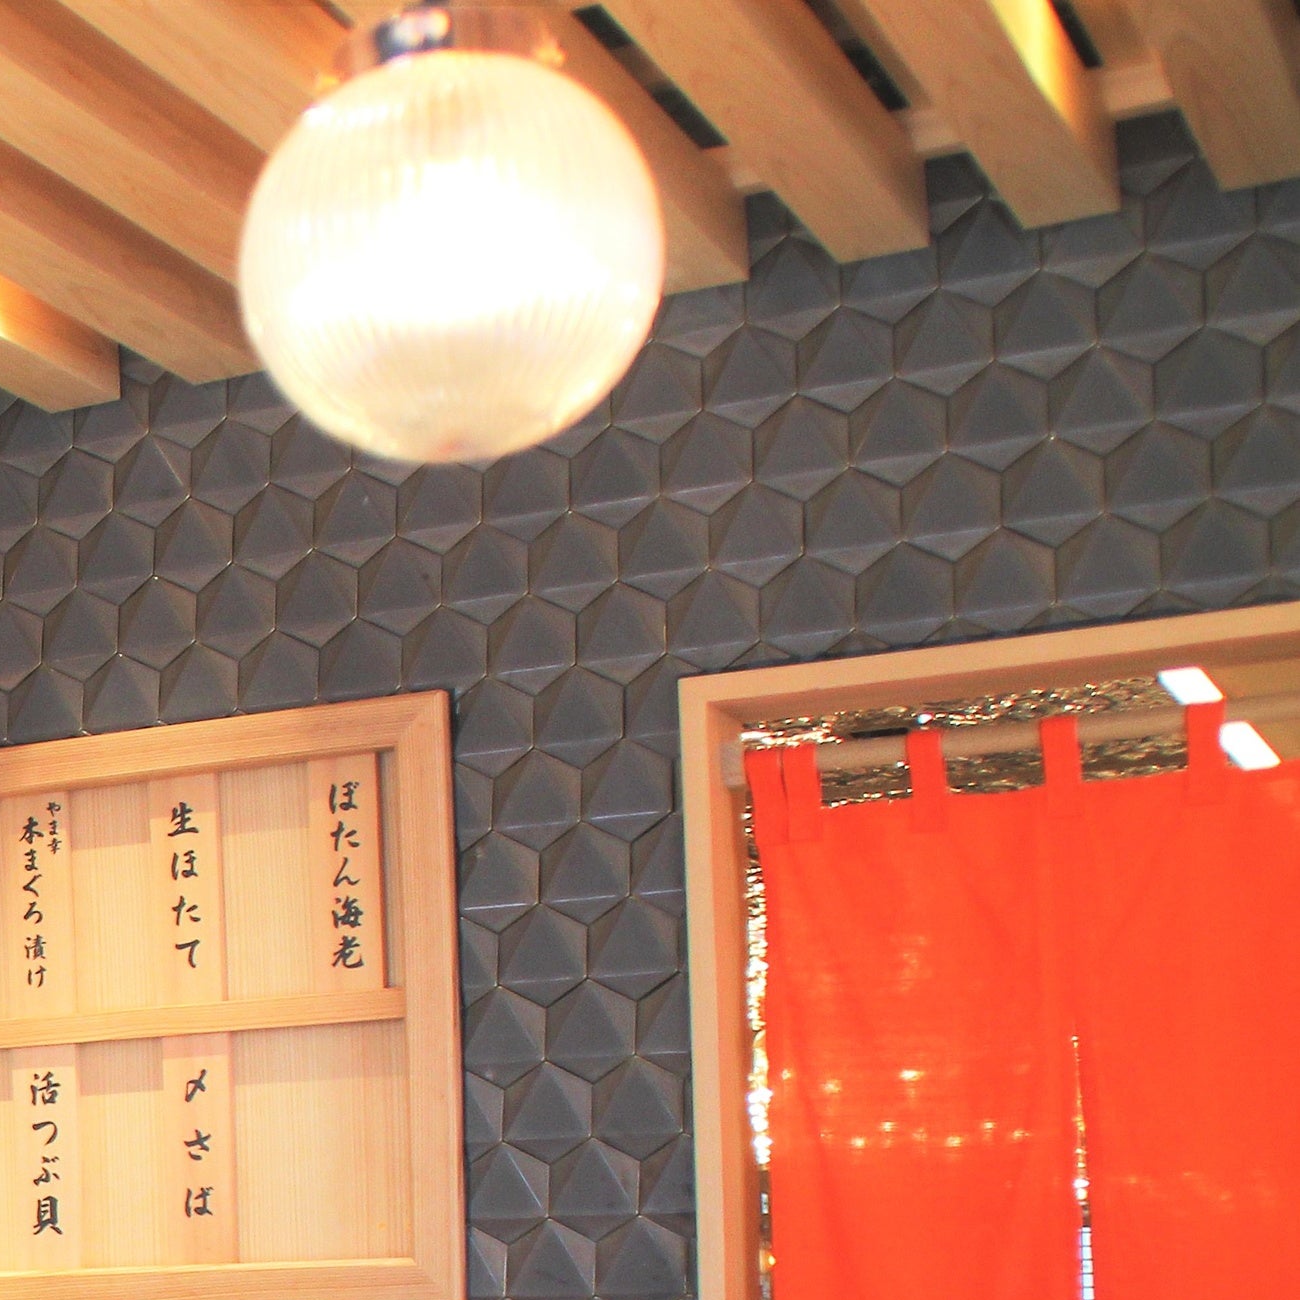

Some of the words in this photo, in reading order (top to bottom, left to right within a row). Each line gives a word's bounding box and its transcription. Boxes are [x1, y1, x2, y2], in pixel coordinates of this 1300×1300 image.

[46, 802, 62, 855] やま幸
[167, 801, 201, 969] 生ほたて
[328, 781, 364, 969] ぼたん海老
[30, 1071, 63, 1236] 活つぶ貝
[183, 1068, 214, 1218] 〆さば
